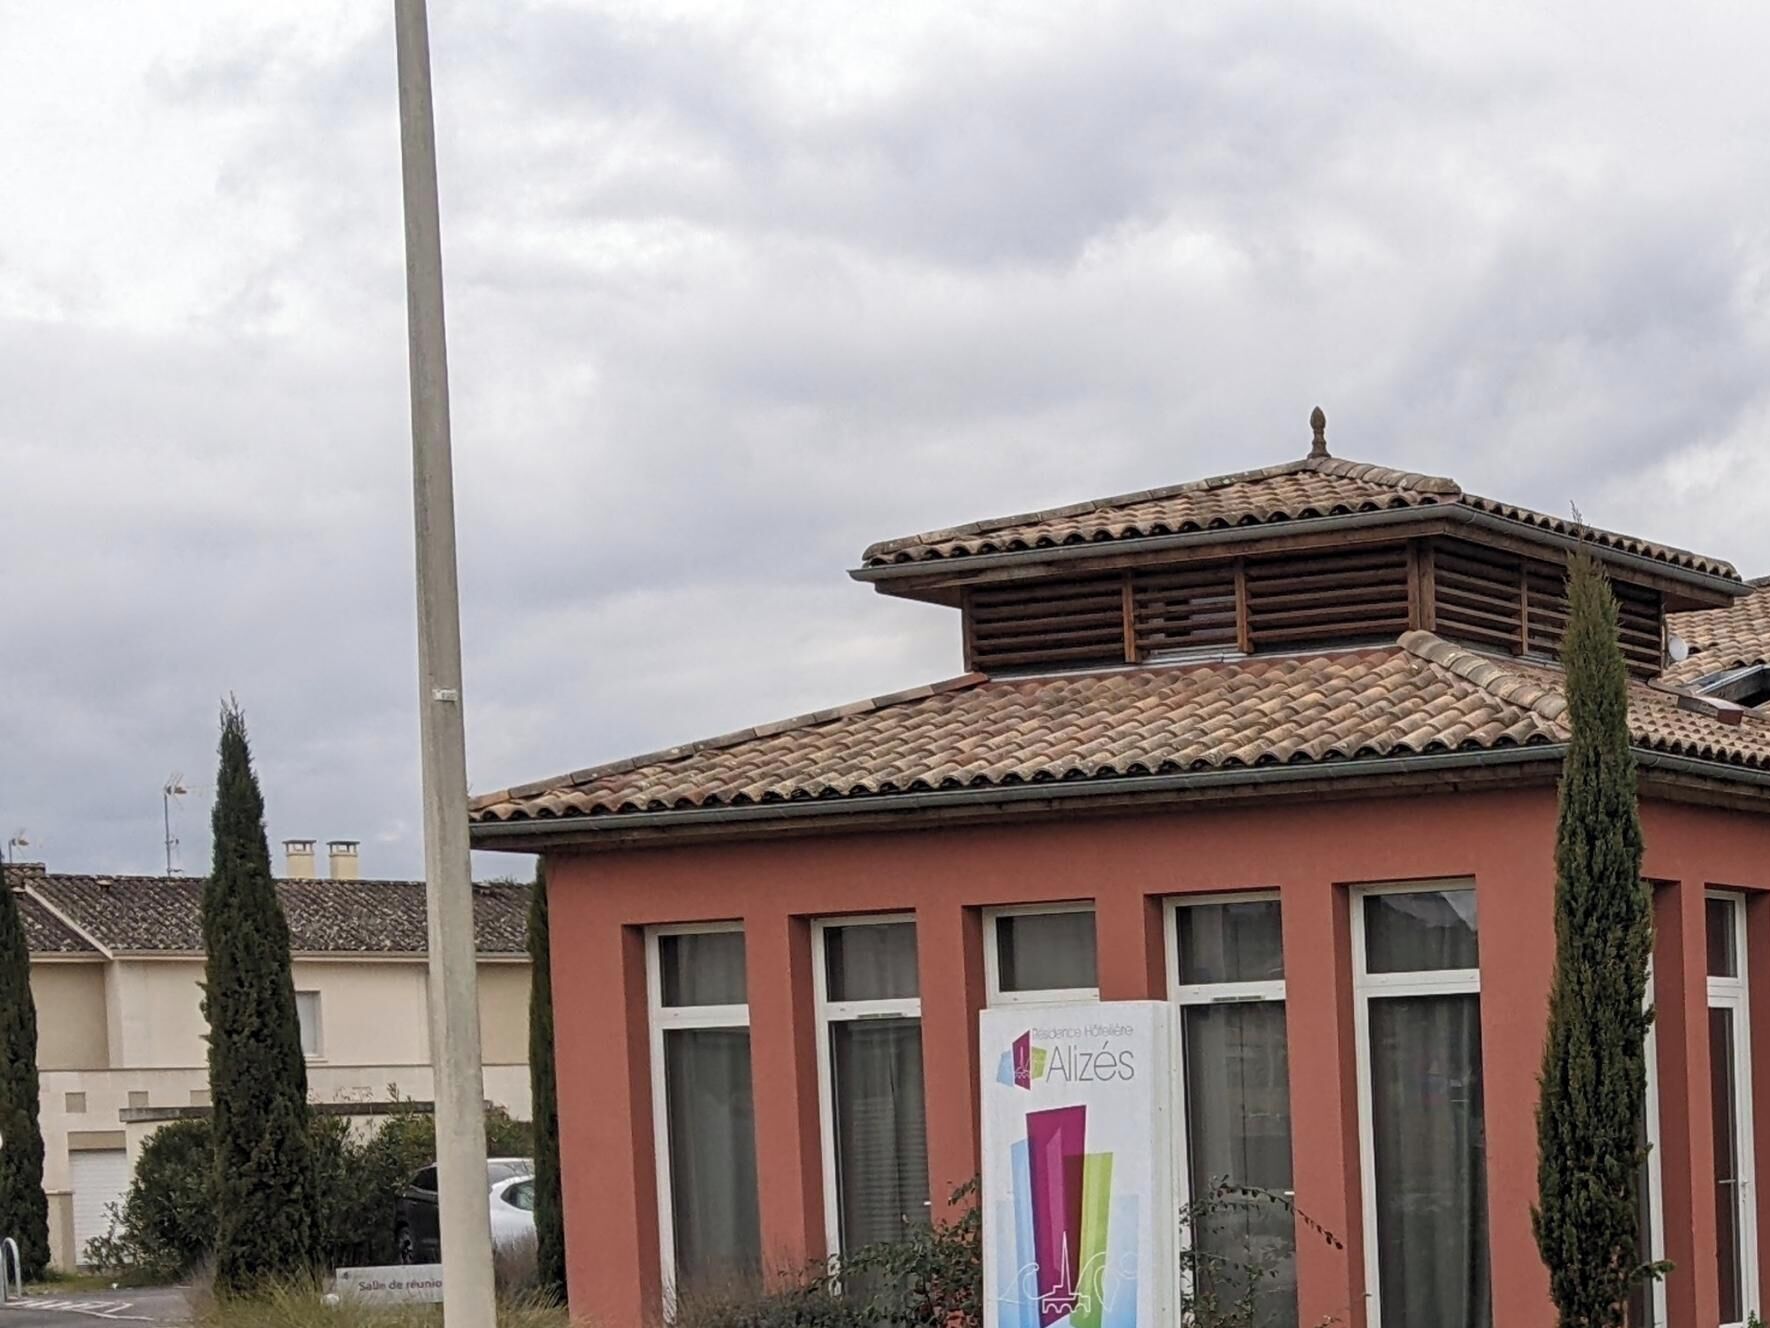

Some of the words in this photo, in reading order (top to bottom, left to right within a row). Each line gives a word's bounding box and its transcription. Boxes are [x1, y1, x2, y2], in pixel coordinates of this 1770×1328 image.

[1032, 1027, 1081, 1040] Résidence
[1084, 1023, 1134, 1038] Hôtelière
[1046, 1040, 1135, 1082] Alizés
[358, 1280, 386, 1291] Salle
[388, 1280, 403, 1290] de
[406, 1279, 442, 1289] réunio
